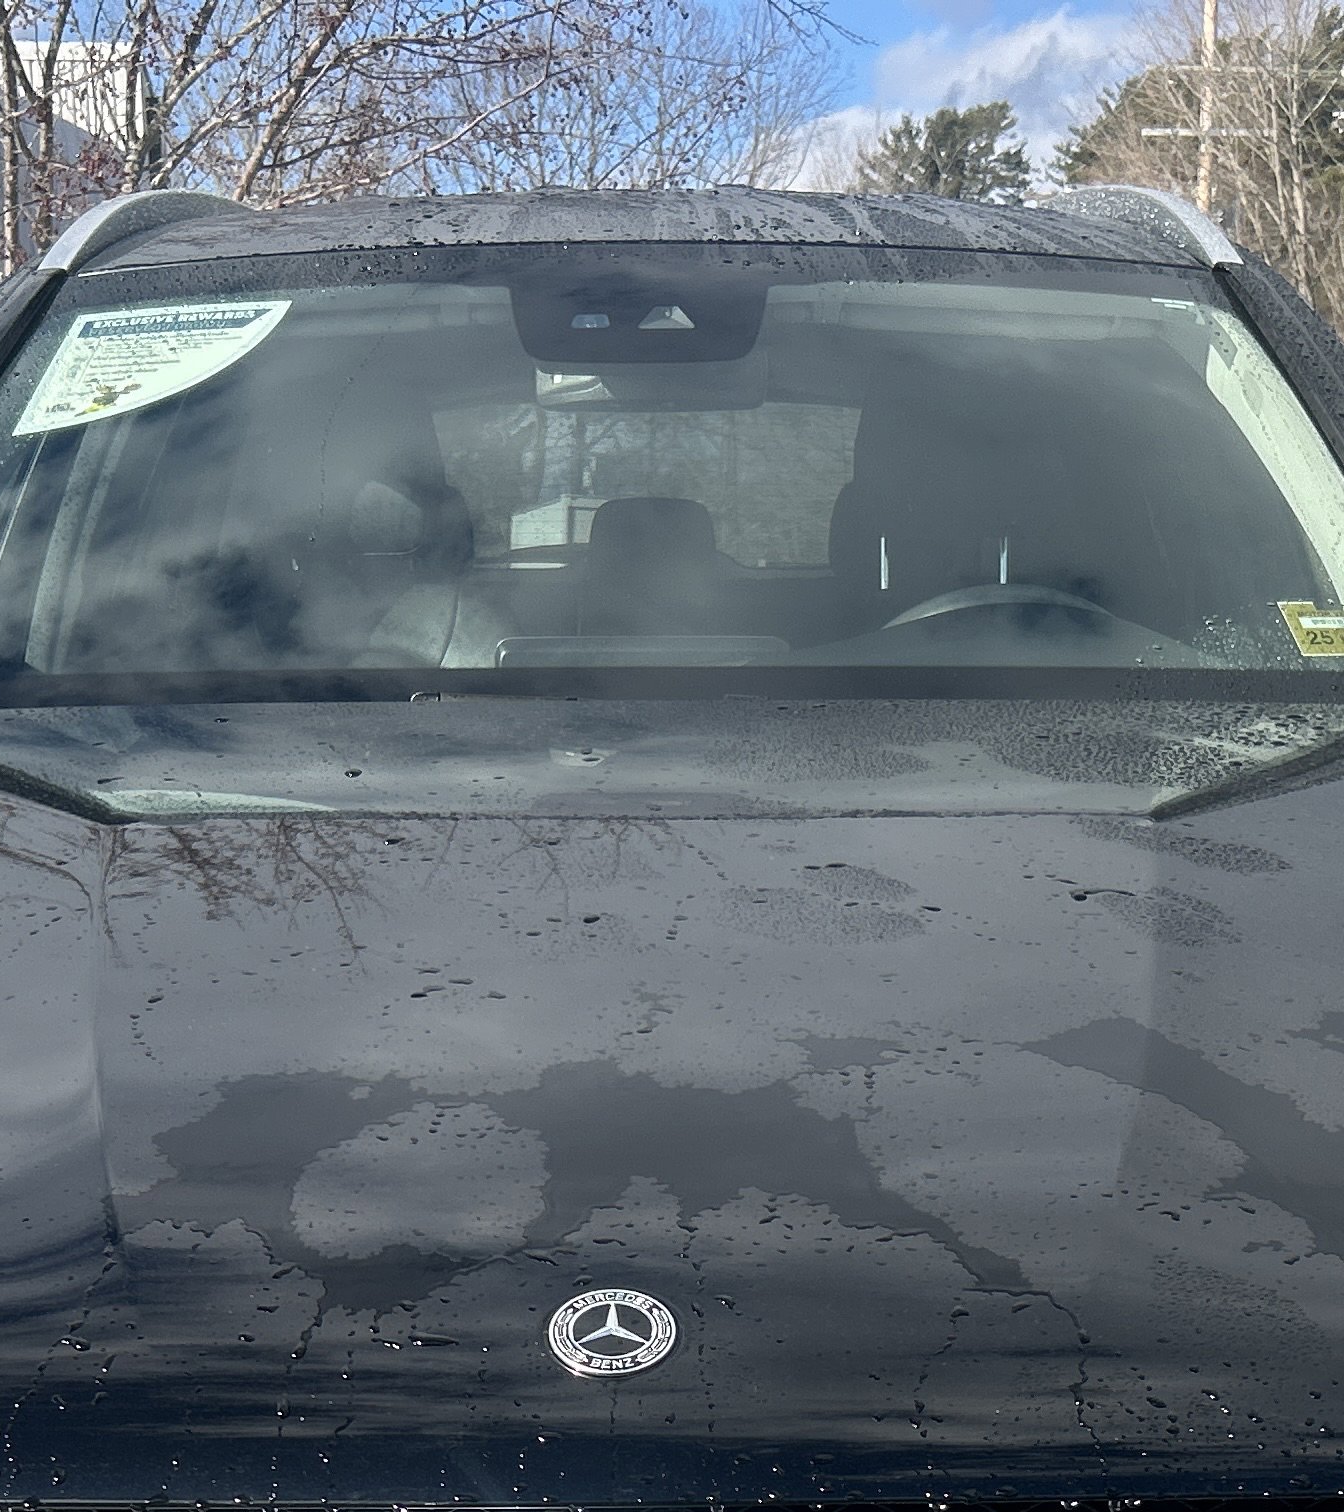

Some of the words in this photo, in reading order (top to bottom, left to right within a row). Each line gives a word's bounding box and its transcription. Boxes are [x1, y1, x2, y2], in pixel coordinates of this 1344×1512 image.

[93, 315, 175, 329] EXCLUSIVE
[178, 310, 256, 322] REWARDS
[1306, 630, 1334, 645] 25
[573, 1292, 654, 1310] MERCEDES
[589, 1357, 635, 1370] BENZ
